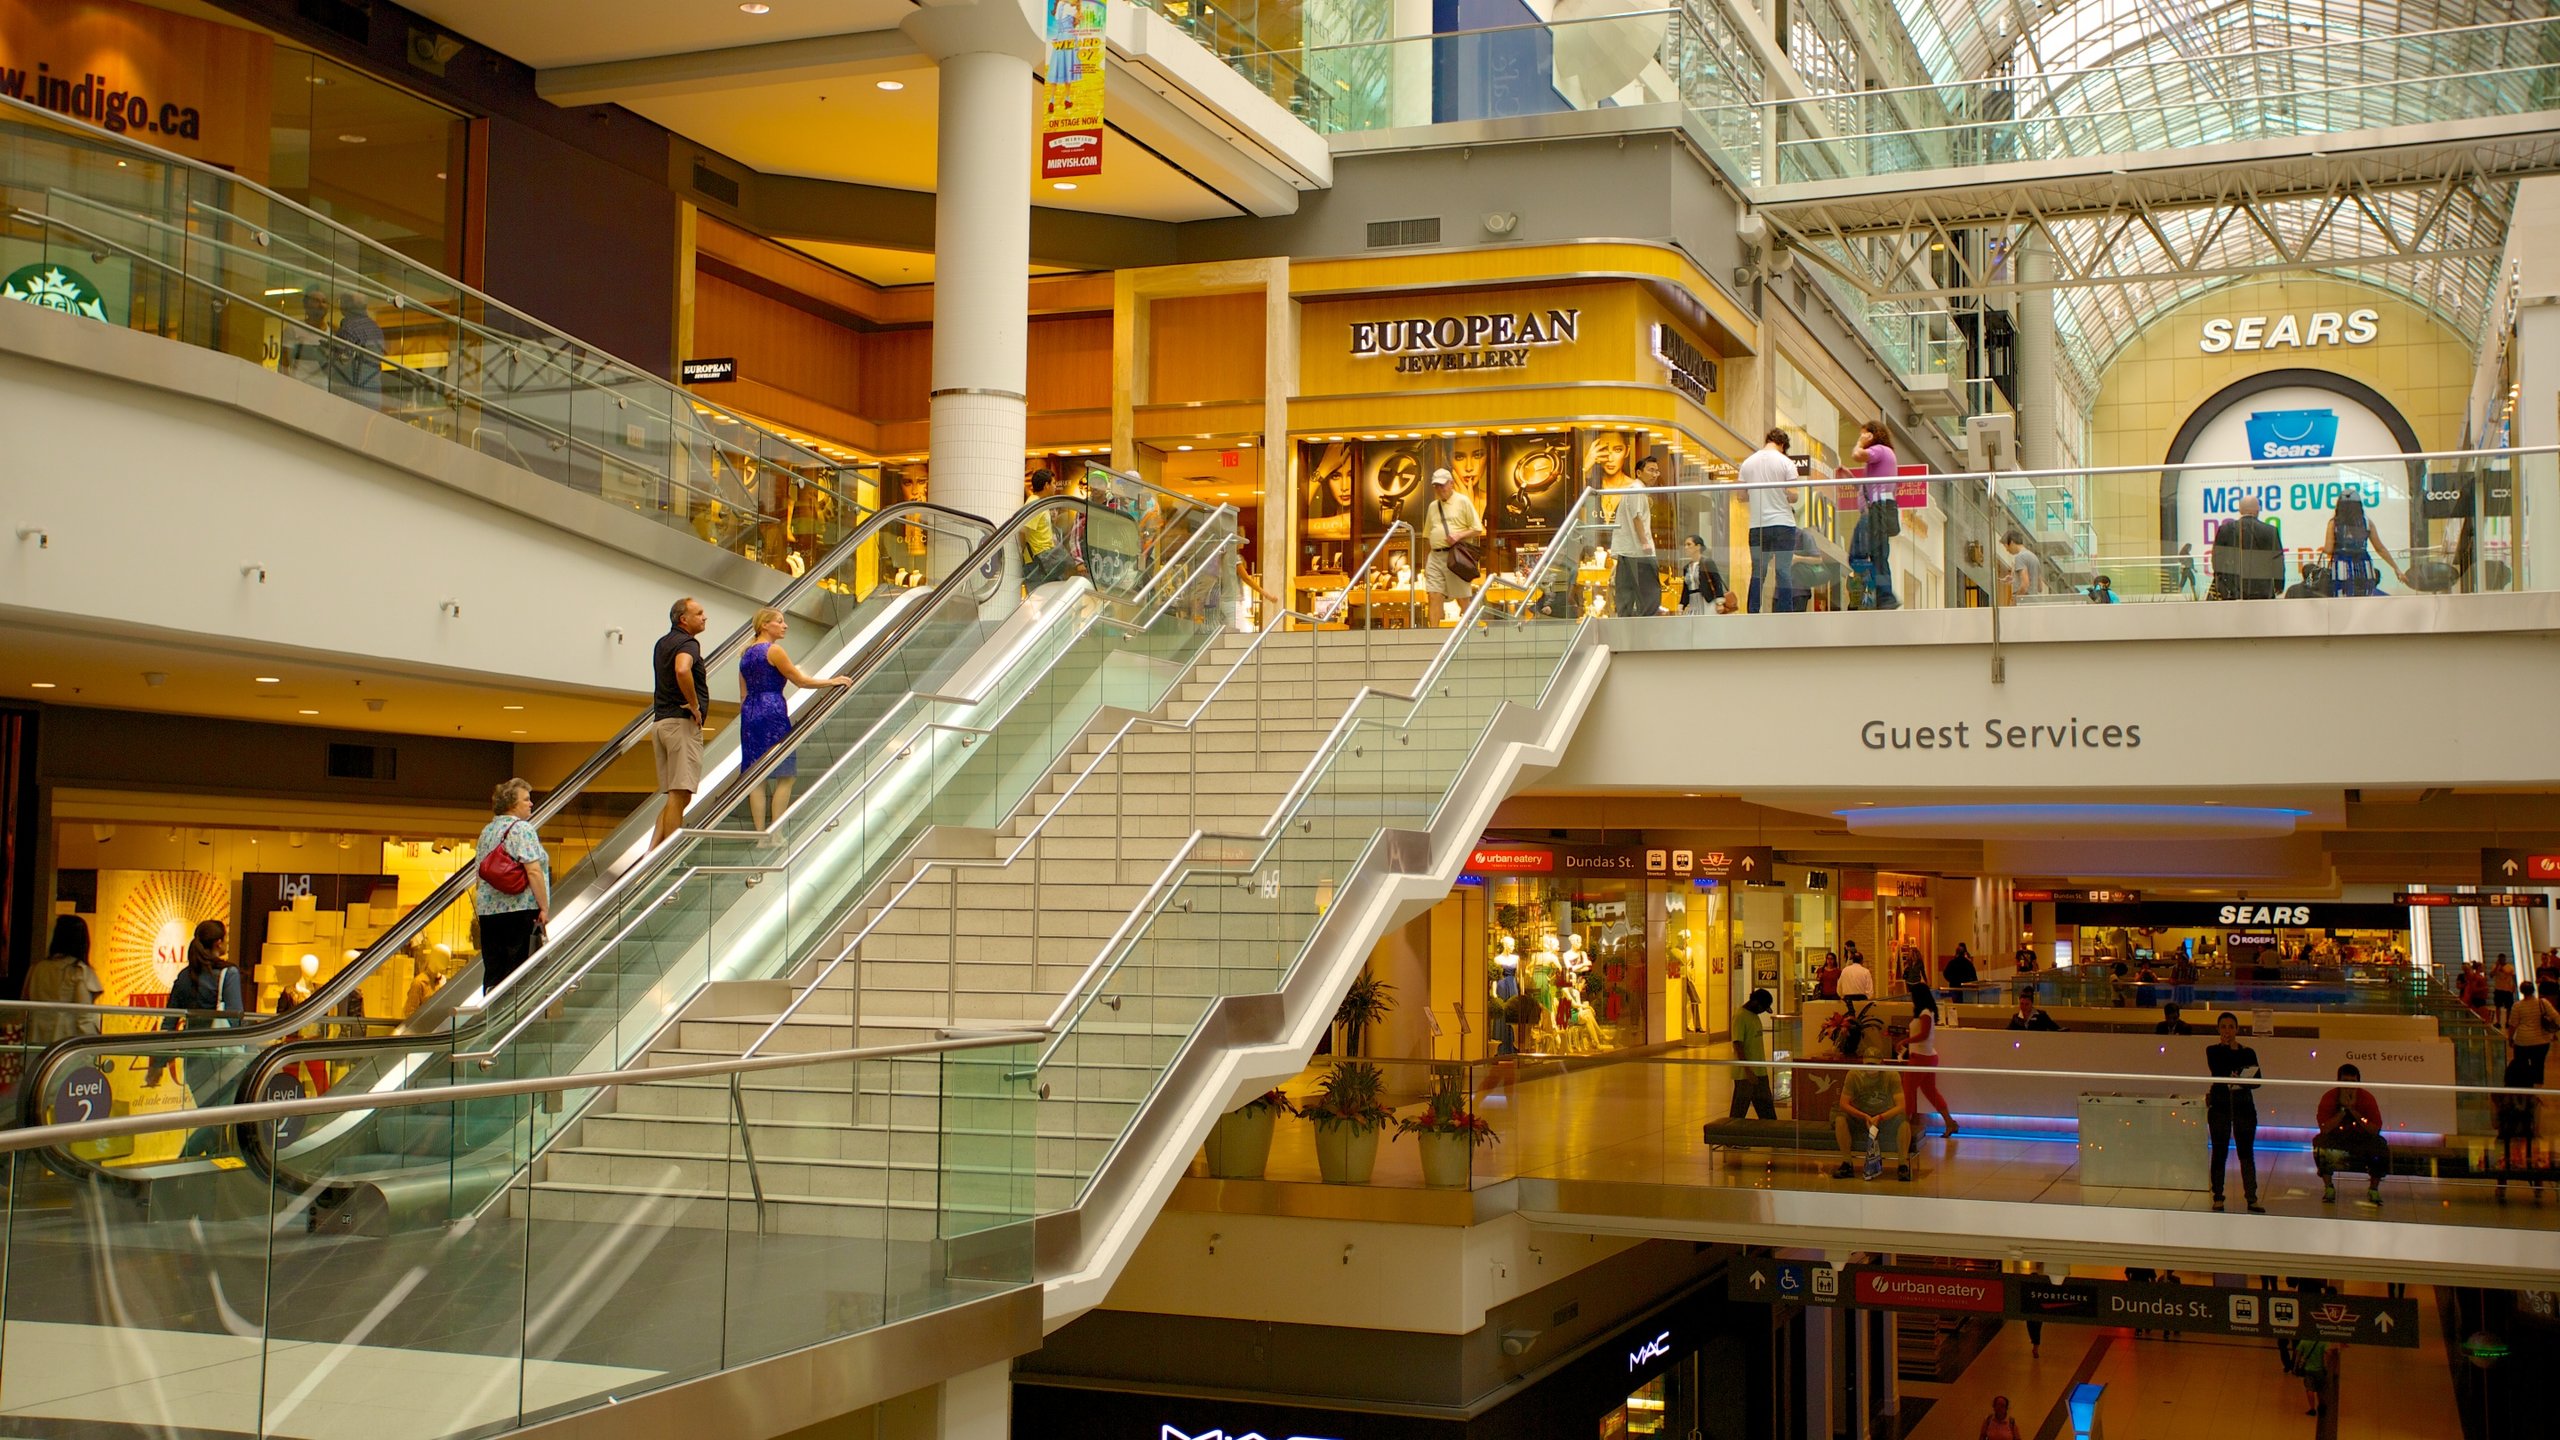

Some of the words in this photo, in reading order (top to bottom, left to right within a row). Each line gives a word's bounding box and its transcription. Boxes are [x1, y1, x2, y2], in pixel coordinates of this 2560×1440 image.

[1048, 119, 1059, 128] ON
[1060, 118, 1080, 127] STAGE
[1082, 116, 1099, 125] NOW
[1047, 156, 1098, 169] MIRVISH.COM
[1350, 309, 1581, 354] EUROPEAN
[2200, 308, 2380, 353] SEARS
[684, 363, 732, 375] EUROPEAN
[1395, 349, 1530, 374] JEWELLERY
[2263, 442, 2321, 458] Sears
[2290, 482, 2380, 512] evey
[2427, 490, 2461, 500] ecco
[1861, 719, 1970, 750] Guest
[1985, 716, 2141, 748] Services
[1486, 854, 1513, 863] urban
[1514, 855, 1542, 865] eatery
[1566, 855, 1615, 868] Dundas
[1618, 856, 1635, 868] St.
[2219, 906, 2311, 925] SEARS
[157, 945, 189, 964] SAL
[2346, 1051, 2377, 1061] Guest
[2380, 1052, 2425, 1063] Services
[68, 1078, 102, 1097] Level
[267, 1085, 298, 1101] Level
[78, 1099, 92, 1122] 2
[1892, 1279, 1935, 1294] urban
[1938, 1284, 1985, 1300] eatery
[2111, 1296, 2183, 1316] Dundas
[2188, 1302, 2213, 1318] St.
